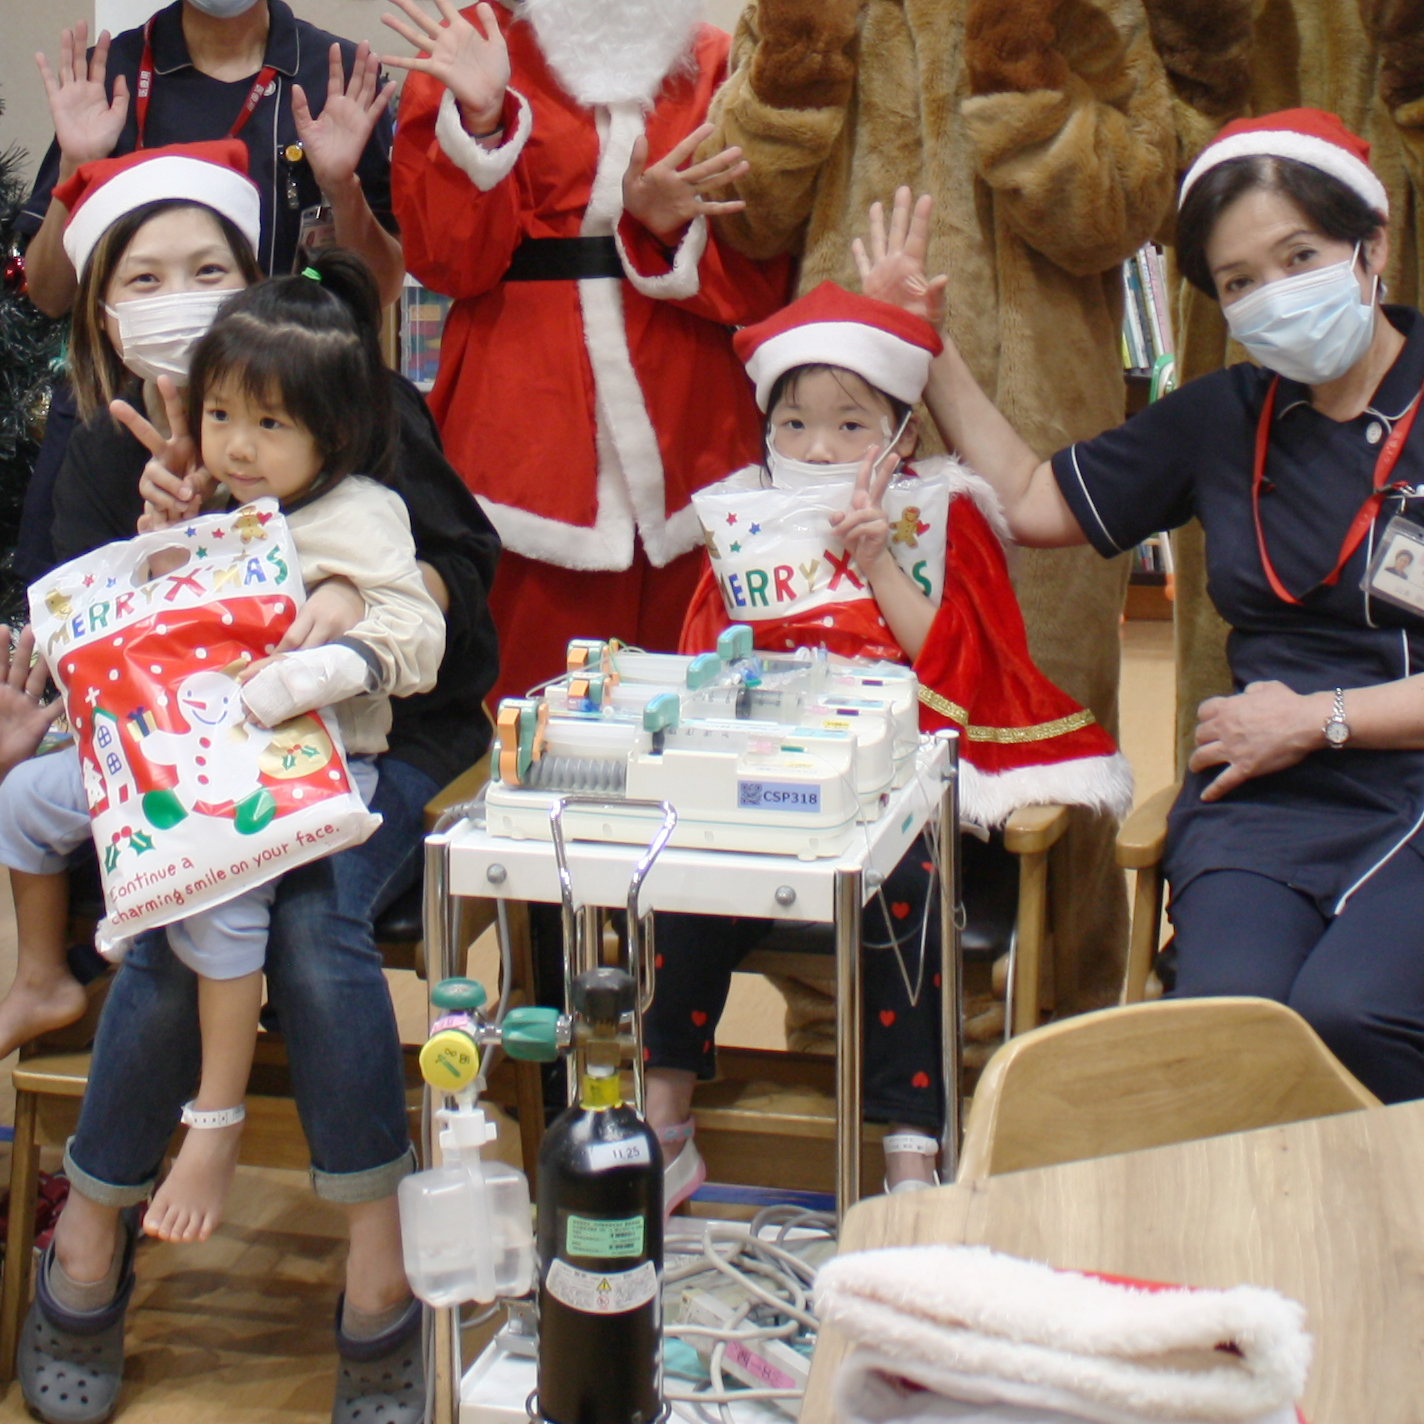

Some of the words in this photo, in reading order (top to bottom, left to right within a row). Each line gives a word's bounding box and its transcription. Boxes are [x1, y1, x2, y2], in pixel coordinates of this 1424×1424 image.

[47, 582, 160, 657] MERRY
[763, 789, 818, 805] CSP318
[110, 888, 185, 926] charming
[185, 866, 227, 896] smile
[229, 859, 249, 876] on
[251, 842, 289, 868] your
[295, 823, 341, 848] face.
[182, 856, 196, 871] a
